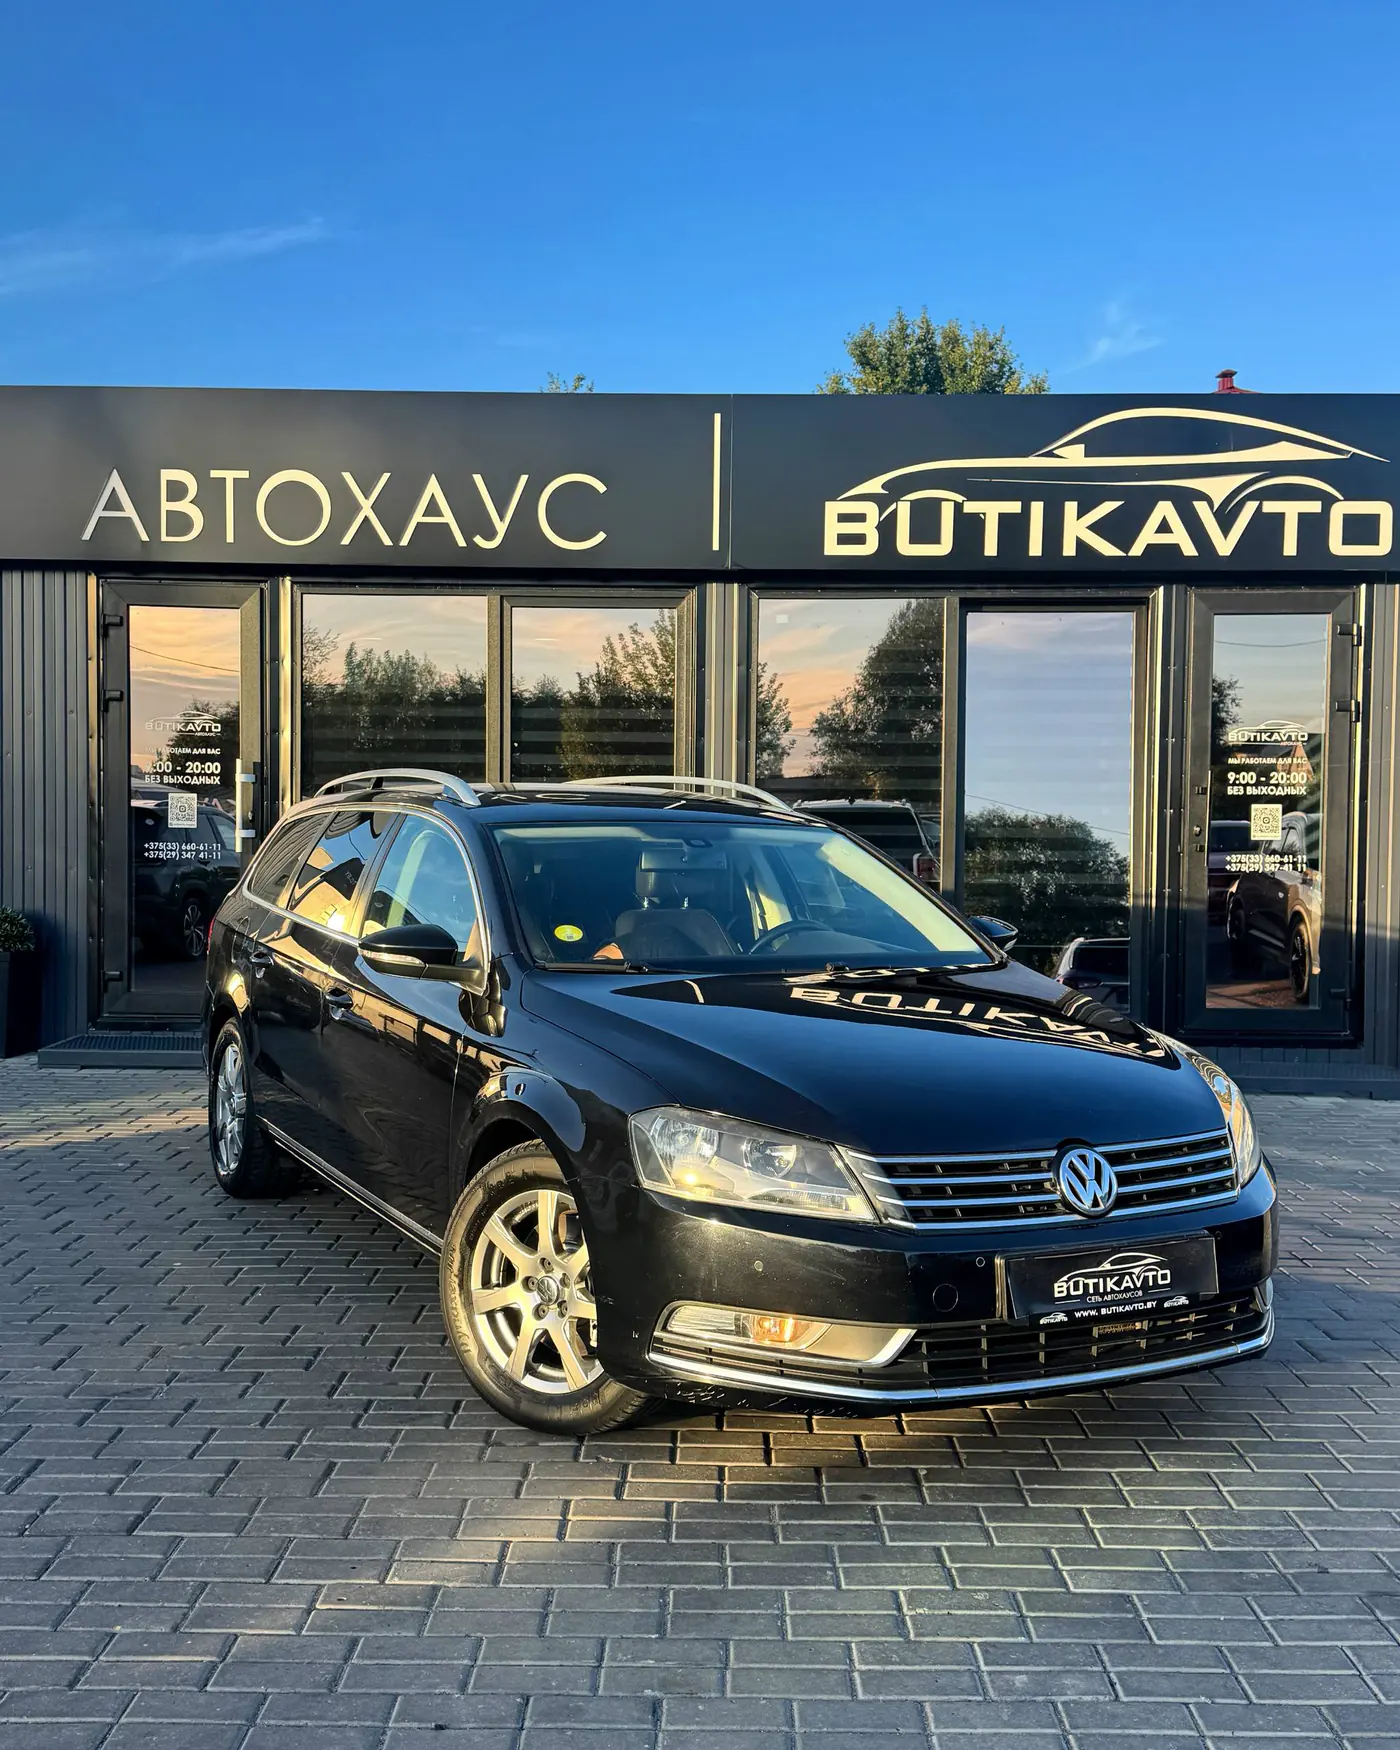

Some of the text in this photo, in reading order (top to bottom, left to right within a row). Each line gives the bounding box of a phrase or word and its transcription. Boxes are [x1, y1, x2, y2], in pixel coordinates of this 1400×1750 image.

[81, 467, 608, 551] АВТОХАУС
[823, 499, 1394, 557] BUTIKAVTO
[145, 722, 222, 732] BUTIKAVTO
[1228, 732, 1308, 742] BUTIKAVTO
[1228, 757, 1307, 765] МЫ РАБОТАЕМ ДЛЯ ВАС
[185, 761, 221, 774] 20:00
[144, 775, 221, 785] БЕЗ ВЫХОДНЫХ
[1228, 772, 1256, 784] 9:00
[1269, 772, 1307, 784] 20:00
[1227, 786, 1307, 796] БЕЗ ВЫХОДНЫХ
[143, 842, 221, 851] +375(33) 660-61-11
[143, 851, 180, 860] +375(29)
[1225, 854, 1307, 864] +375(33) 660-61-11
[1053, 1269, 1171, 1298] BUTIKAVTO
